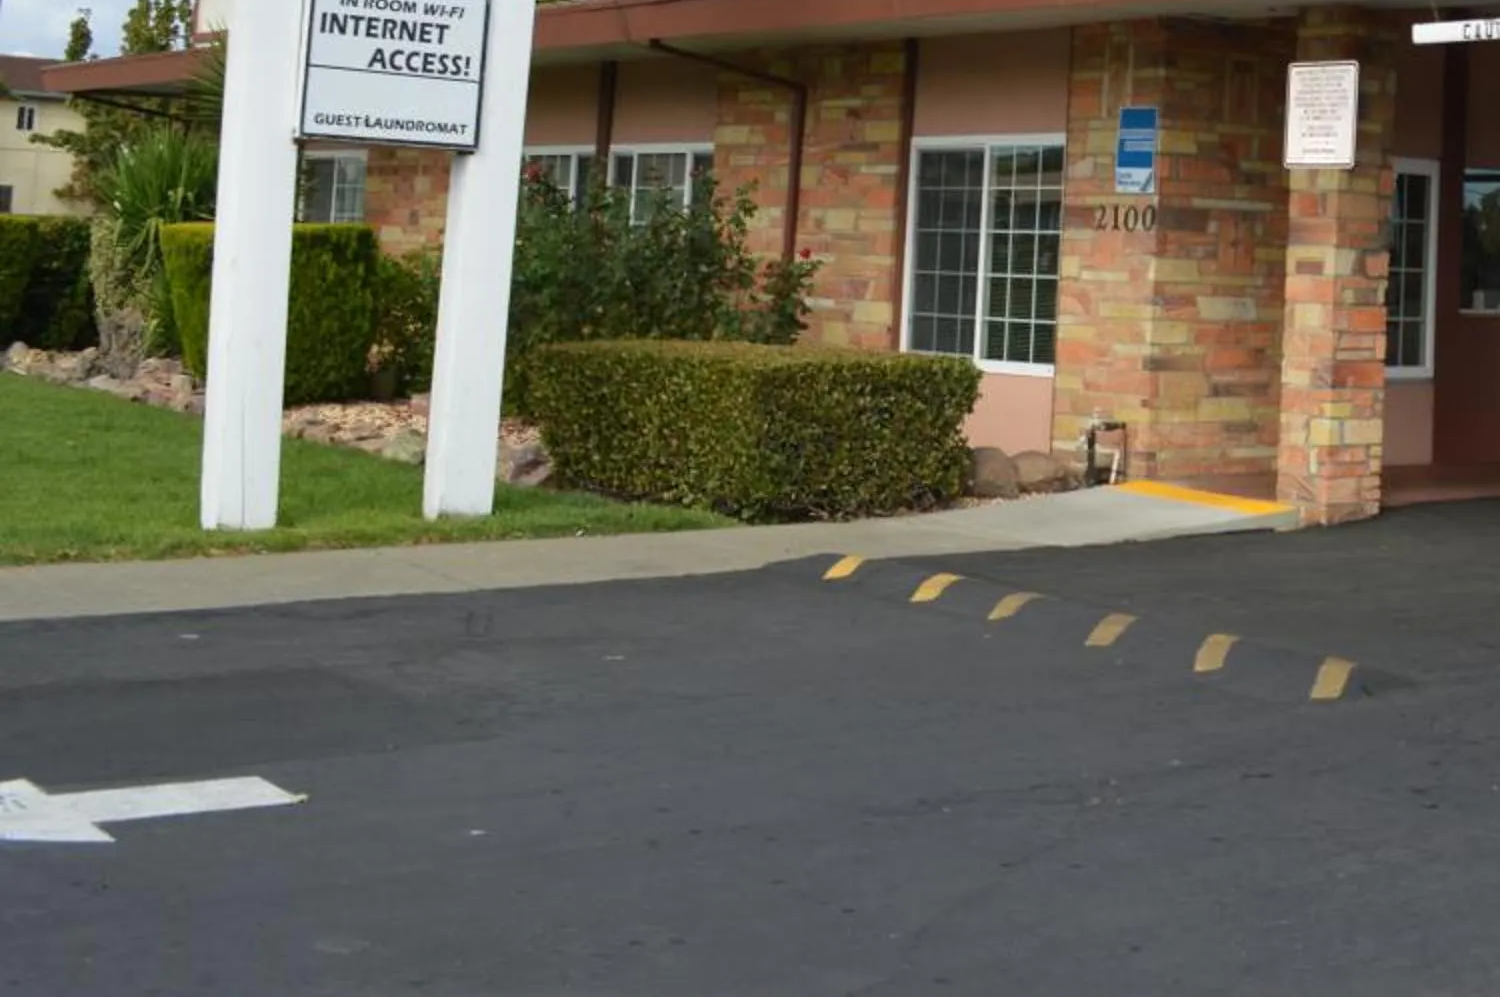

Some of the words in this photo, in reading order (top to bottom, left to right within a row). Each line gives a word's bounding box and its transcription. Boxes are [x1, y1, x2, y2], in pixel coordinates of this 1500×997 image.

[423, 4, 466, 19] WI-FI
[319, 12, 450, 45] INTERNET
[367, 48, 471, 77] ACCESS!
[1095, 203, 1156, 232] 2100
